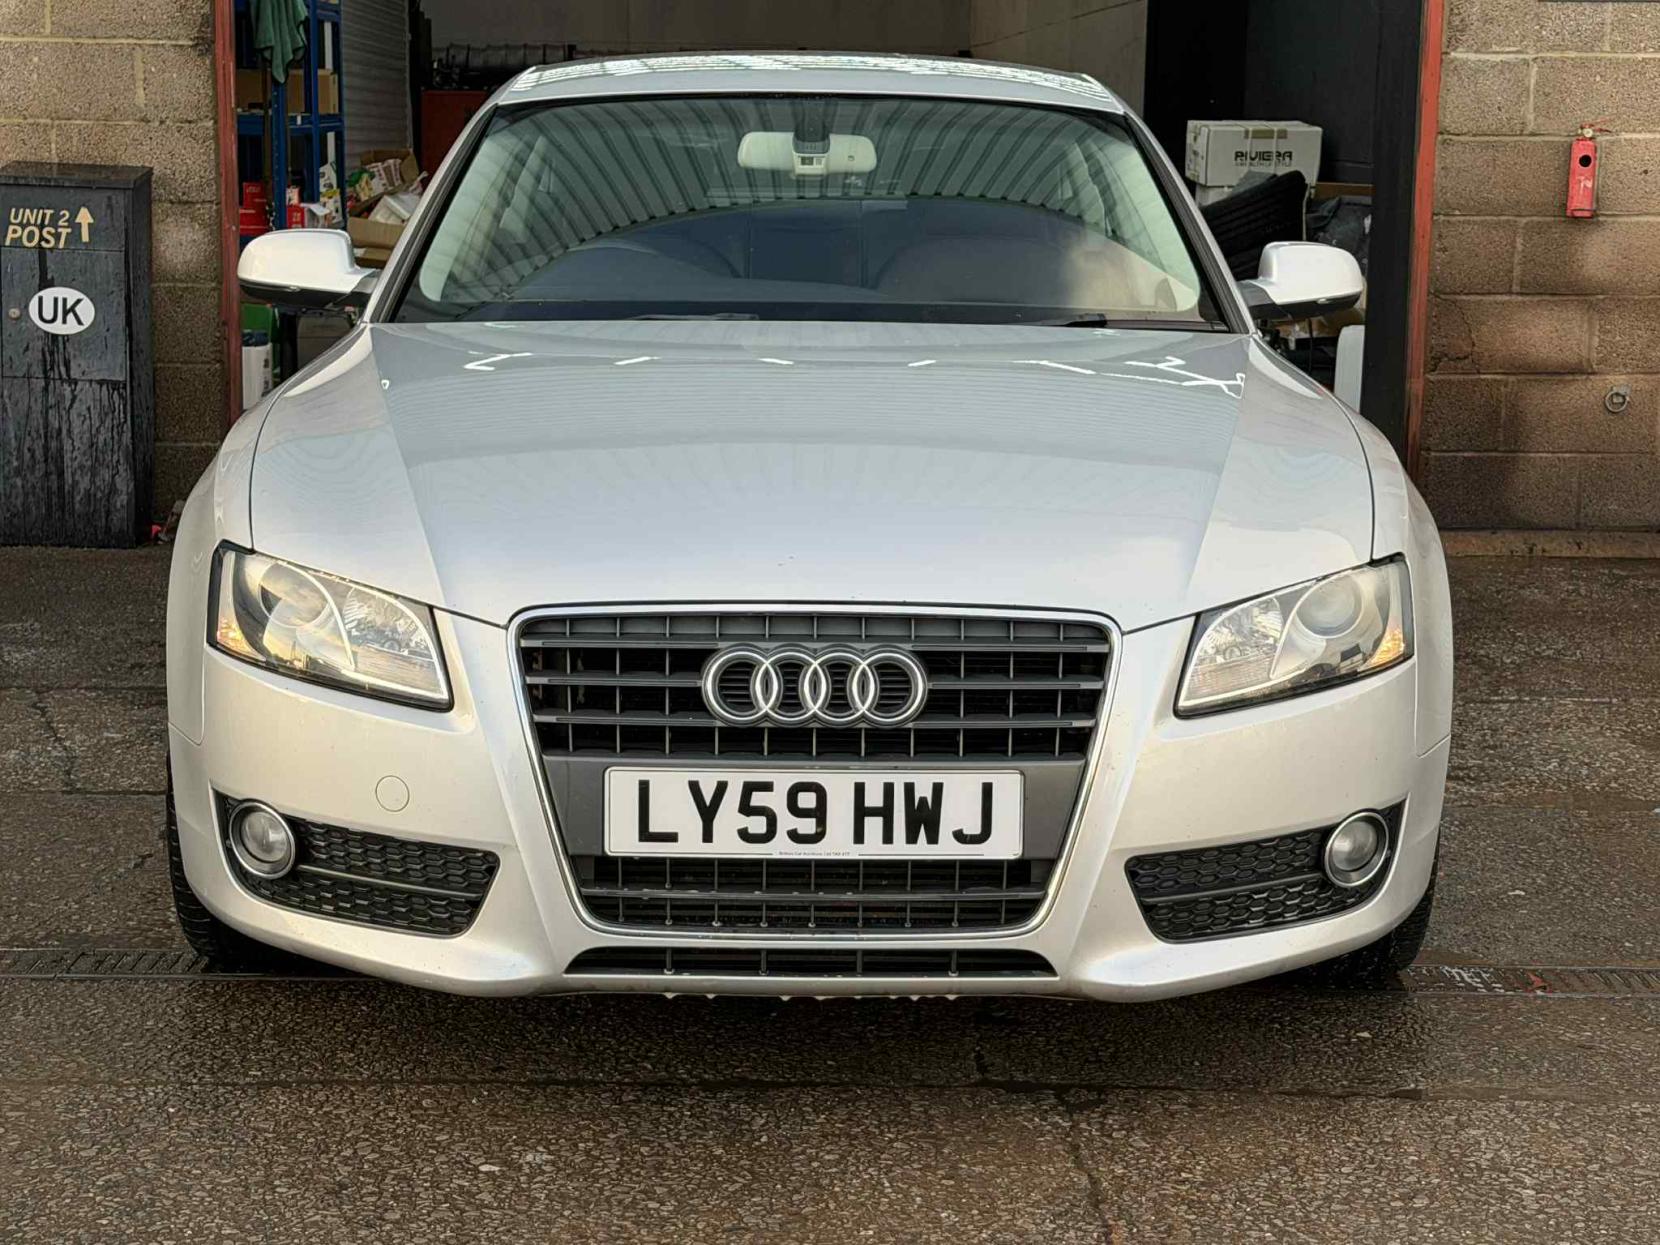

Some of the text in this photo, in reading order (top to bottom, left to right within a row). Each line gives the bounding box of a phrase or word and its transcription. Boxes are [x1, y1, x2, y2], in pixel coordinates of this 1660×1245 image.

[1234, 151, 1293, 161] RIVIERA
[10, 208, 70, 226] UNIT 2
[5, 225, 72, 249] POST
[38, 295, 84, 326] UK
[638, 779, 993, 845] LY59 HWJ
